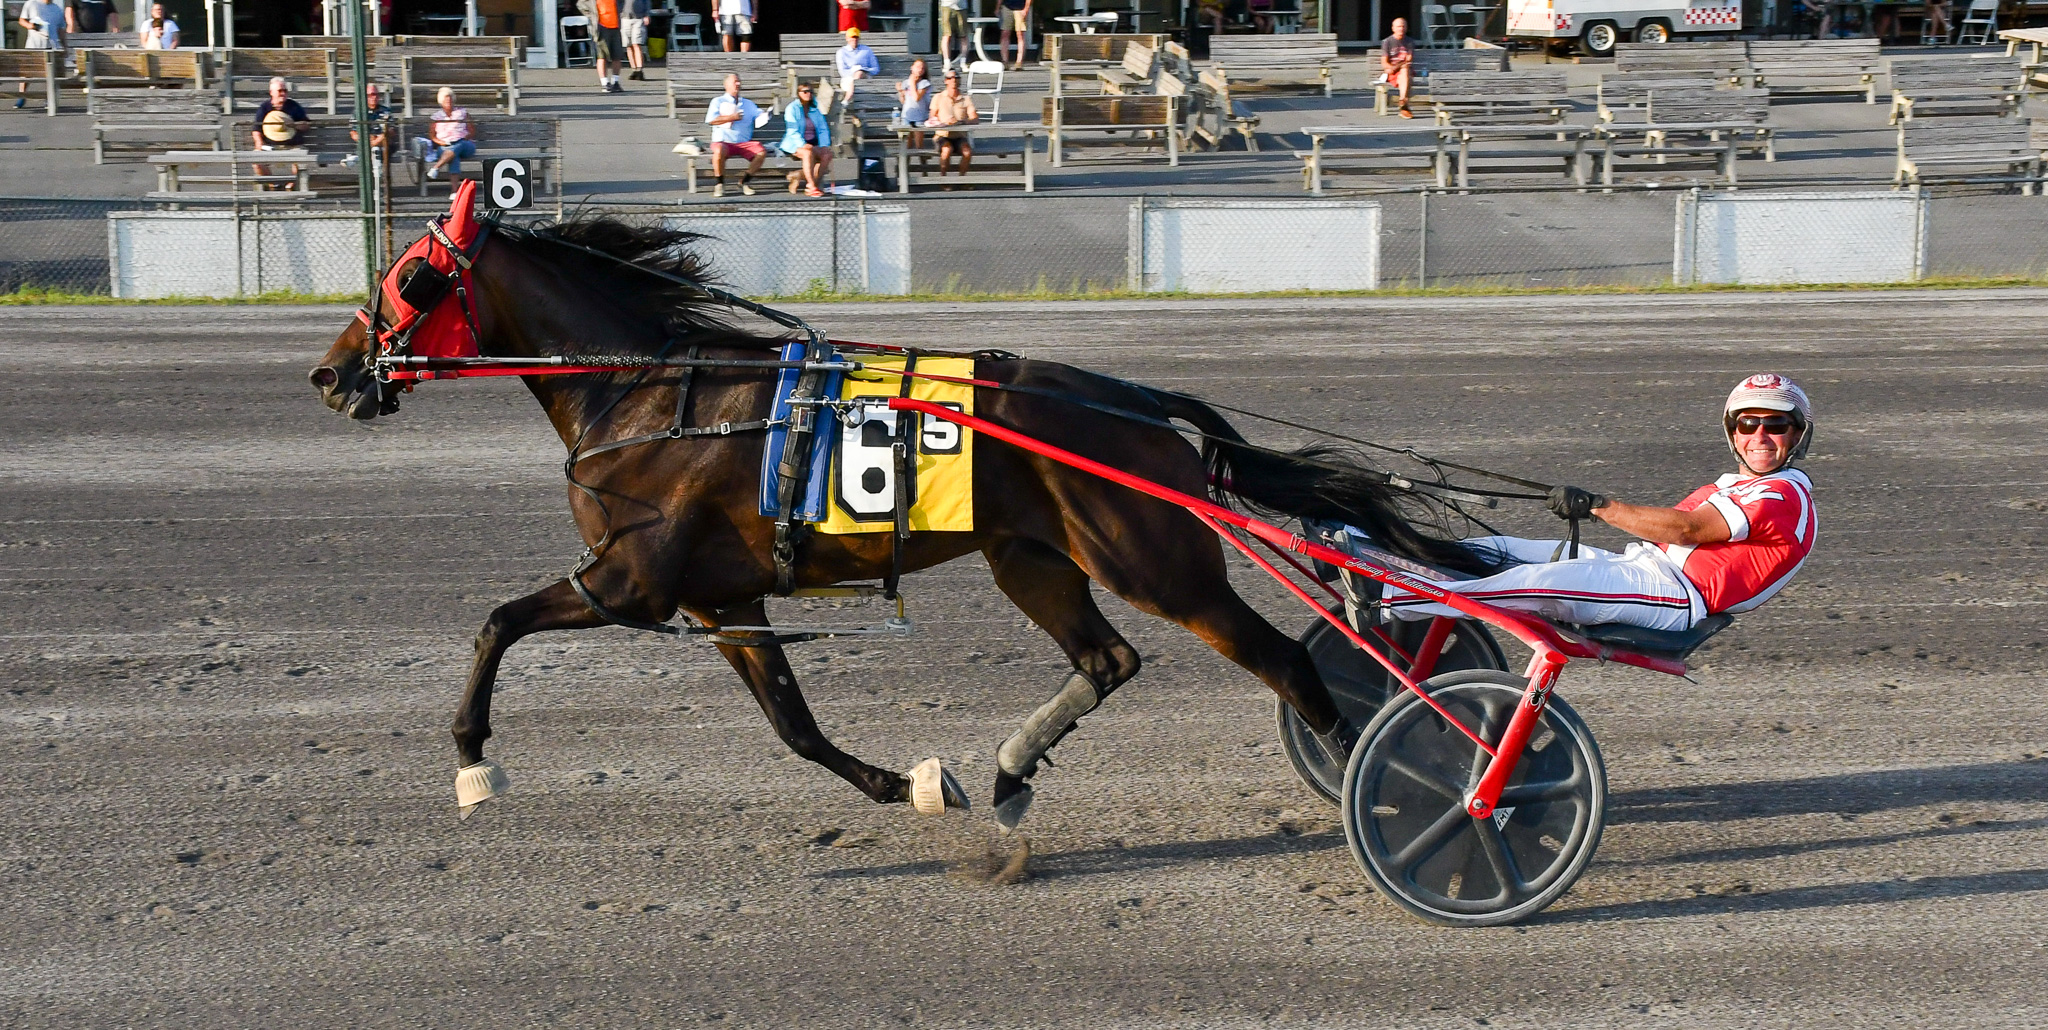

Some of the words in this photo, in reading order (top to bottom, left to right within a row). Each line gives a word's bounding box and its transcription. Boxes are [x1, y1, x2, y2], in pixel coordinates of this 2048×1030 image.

[492, 159, 525, 208] 6
[923, 406, 960, 450] 5
[842, 404, 899, 513] 6
[1345, 558, 1384, 577] Jimmy
